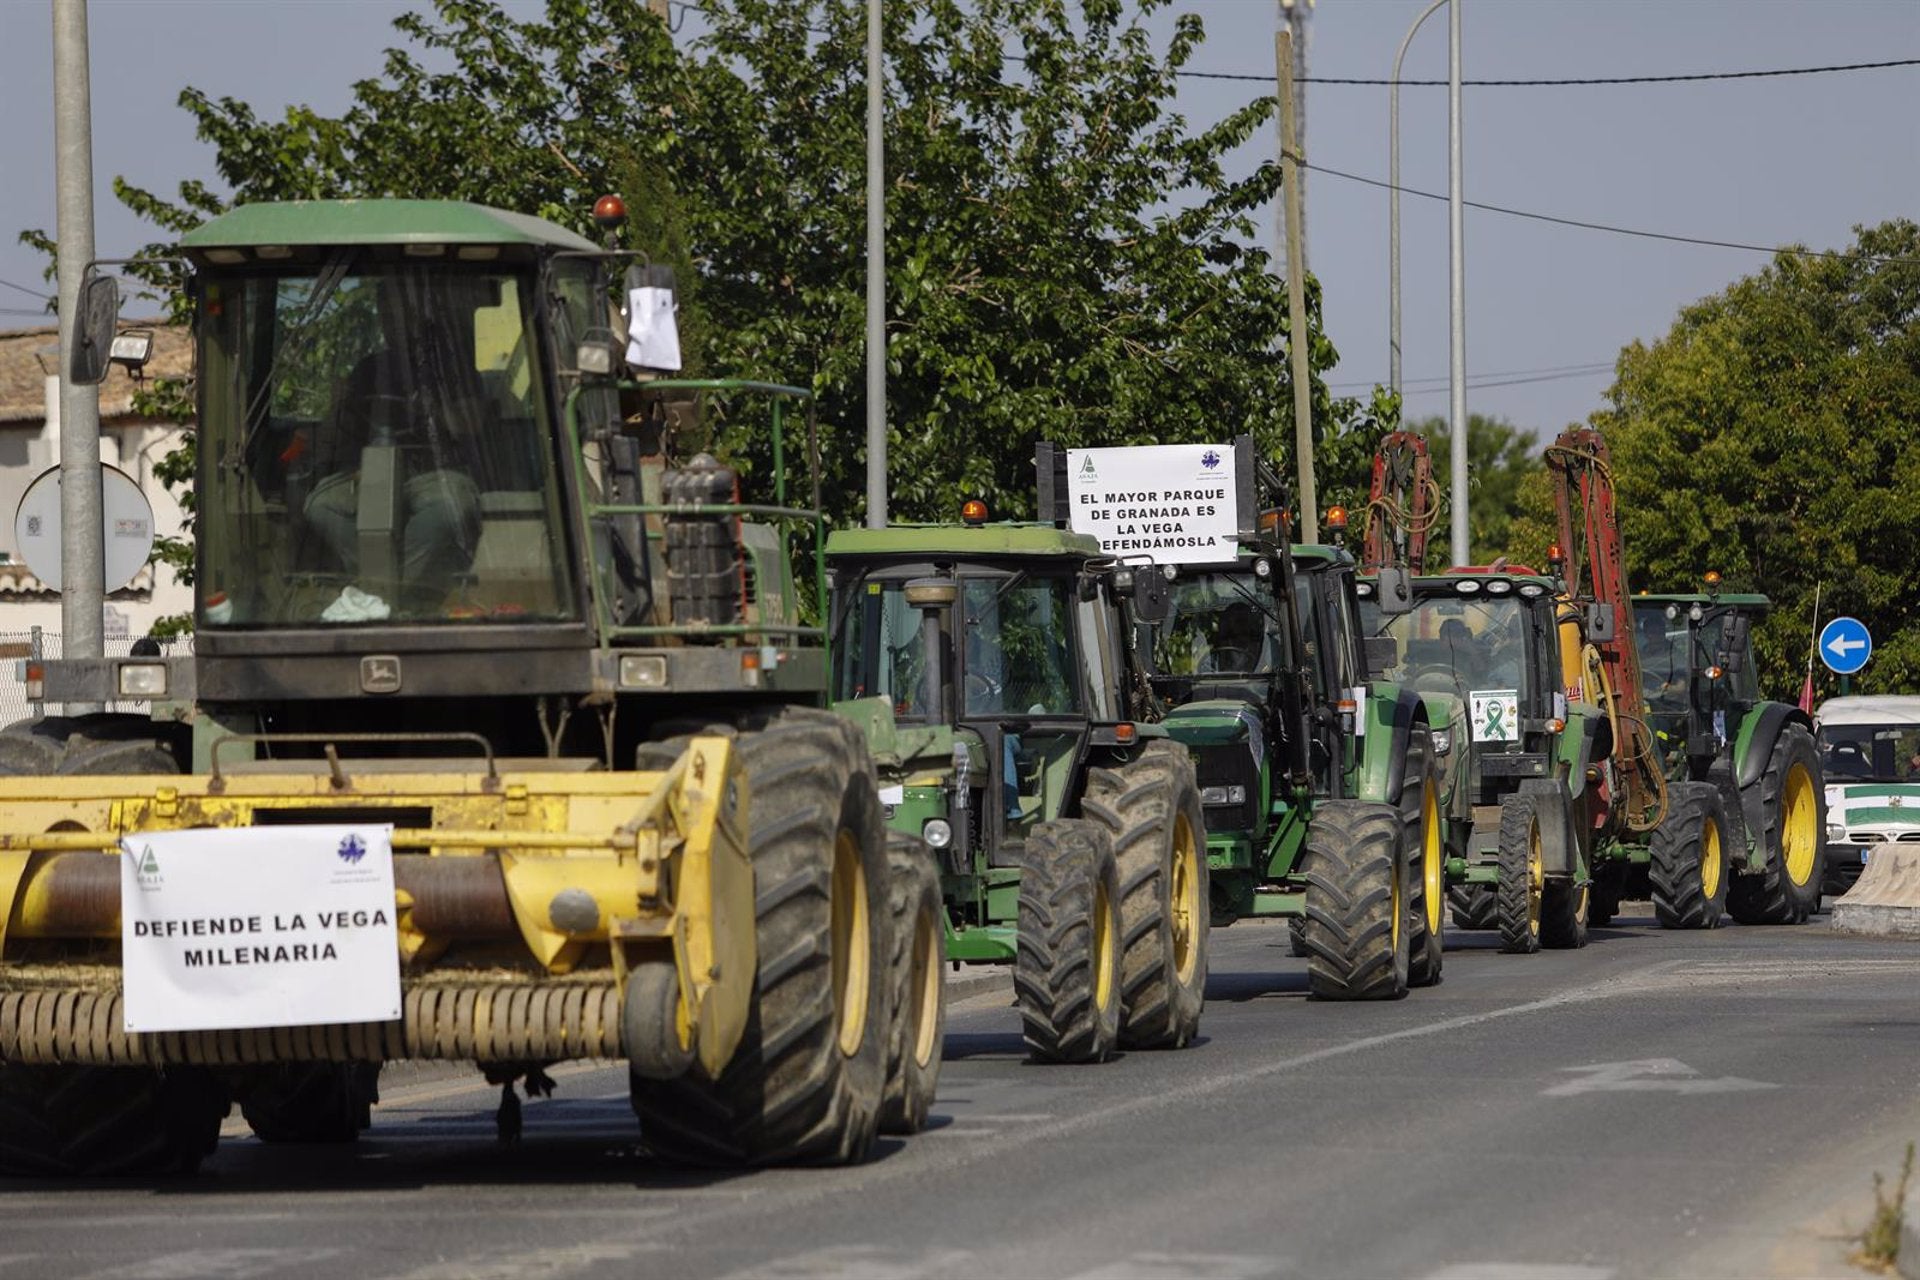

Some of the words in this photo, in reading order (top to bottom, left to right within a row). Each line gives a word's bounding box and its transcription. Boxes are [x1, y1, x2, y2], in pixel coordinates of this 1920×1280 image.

[1080, 493, 1099, 505] EL
[1105, 491, 1158, 504] MAYOR
[1163, 488, 1226, 502] PARQUE
[1091, 509, 1111, 521] DE
[1116, 507, 1191, 520] GRANADA
[1196, 505, 1216, 517] ES
[1117, 524, 1136, 535] LA
[1141, 522, 1184, 534] VEGA
[134, 916, 262, 938] DEFIENDE
[274, 913, 306, 932] LA
[318, 909, 388, 930] VEGA
[184, 943, 338, 967] MILENARIA
